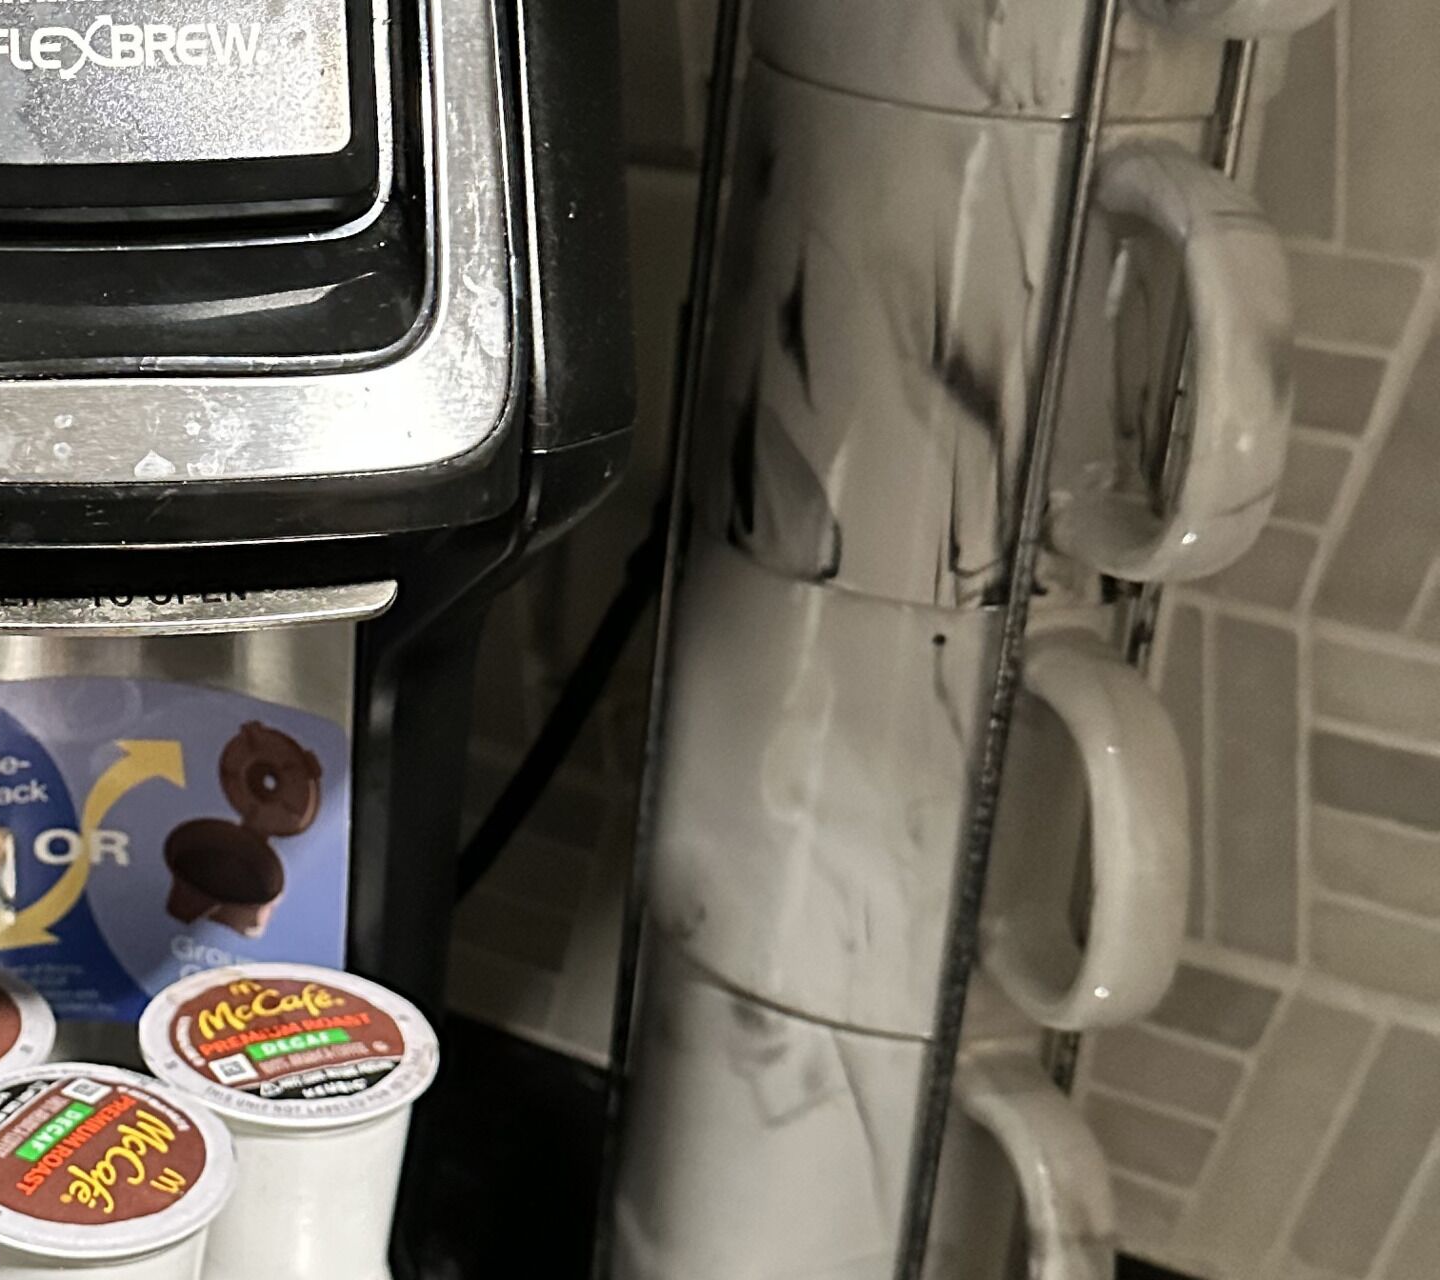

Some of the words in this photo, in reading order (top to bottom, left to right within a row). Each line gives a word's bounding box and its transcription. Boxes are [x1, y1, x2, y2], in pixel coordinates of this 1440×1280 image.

[33, 827, 130, 867] OR
[197, 983, 338, 1039] McCafé
[198, 1022, 302, 1056] PREMIUM
[302, 1012, 372, 1032] ROAST
[260, 1031, 331, 1057] DECAF
[28, 1110, 84, 1151] DECAF
[65, 1093, 138, 1148] PREMIUM
[15, 1140, 73, 1197] ROAST
